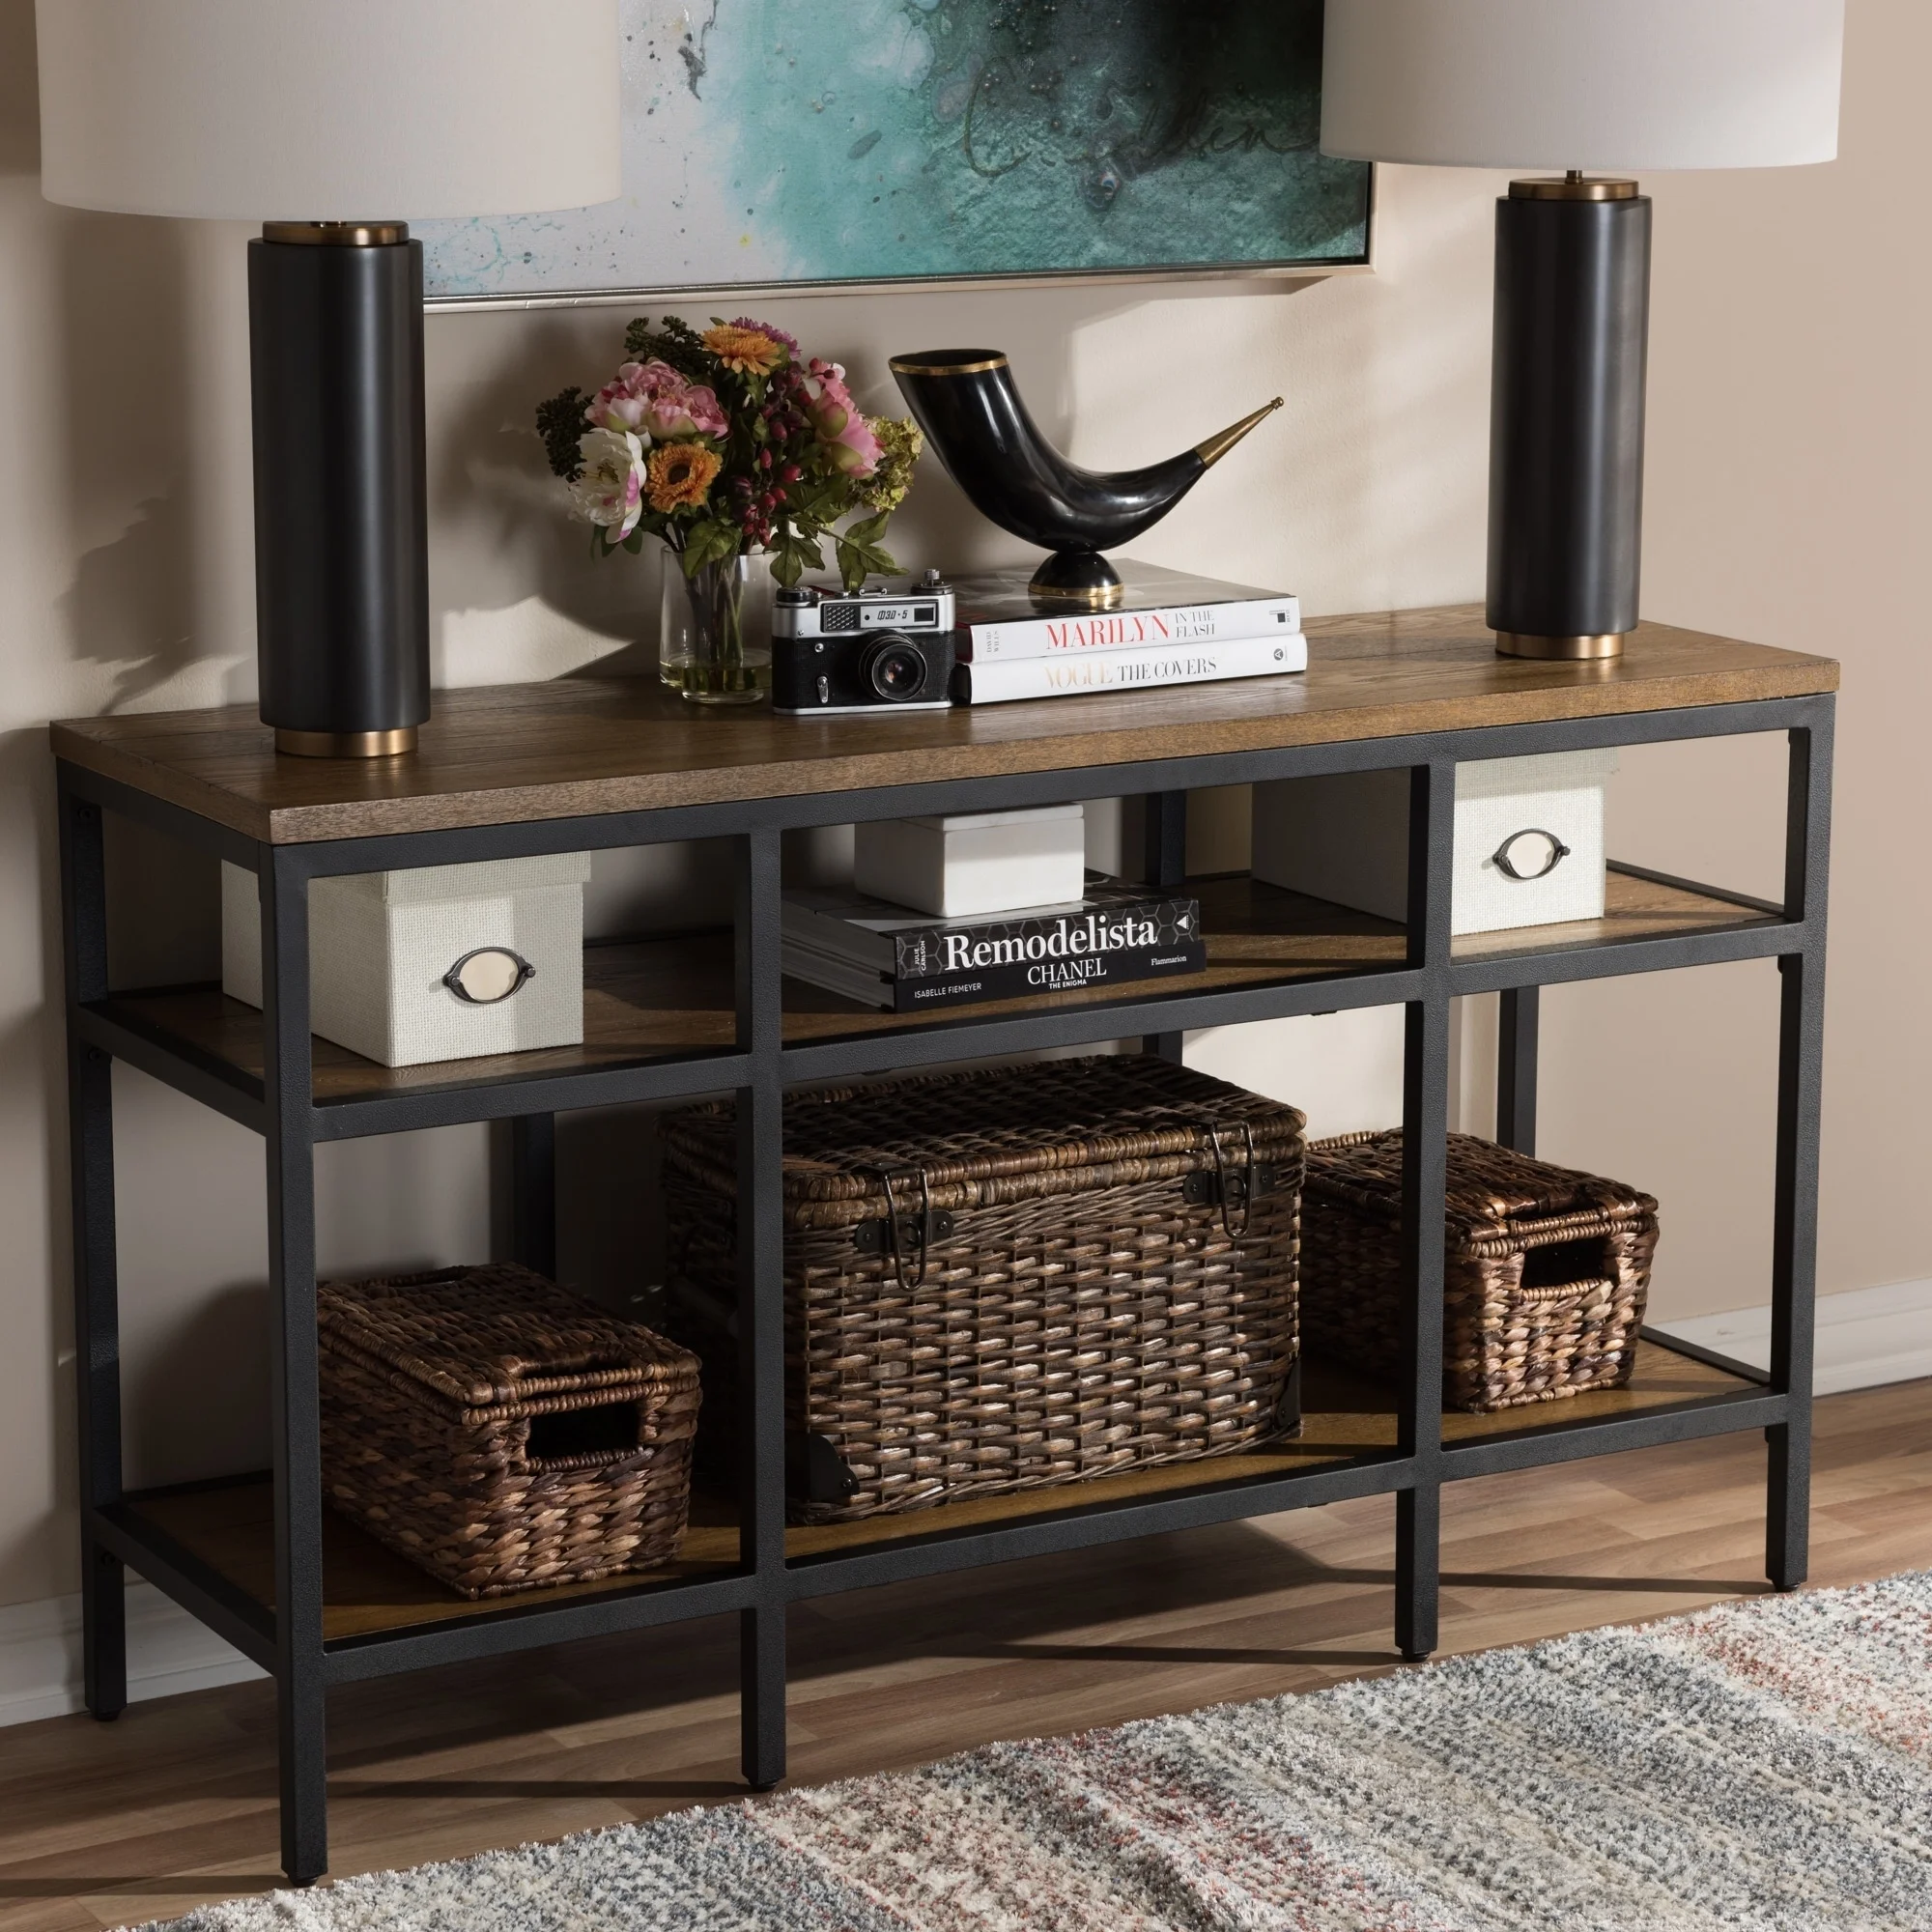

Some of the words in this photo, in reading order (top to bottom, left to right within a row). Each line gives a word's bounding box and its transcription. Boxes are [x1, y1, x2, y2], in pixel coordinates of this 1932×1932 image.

[1175, 611, 1189, 624] IN
[1190, 610, 1214, 622] THE
[1045, 613, 1169, 650] MARILYN
[1176, 623, 1215, 638] FLASH
[1044, 661, 1113, 688] VOGUE
[1117, 663, 1151, 682] THE
[1154, 657, 1217, 677] COVERS
[944, 915, 1157, 971] Remodelista
[1151, 955, 1186, 966] Flammarion
[1027, 957, 1107, 985] CHANEL
[914, 986, 947, 999] ISABELLE
[948, 982, 981, 994] FIEMEYER
[1048, 981, 1061, 990] THE
[1063, 979, 1087, 988] ENIGMA
